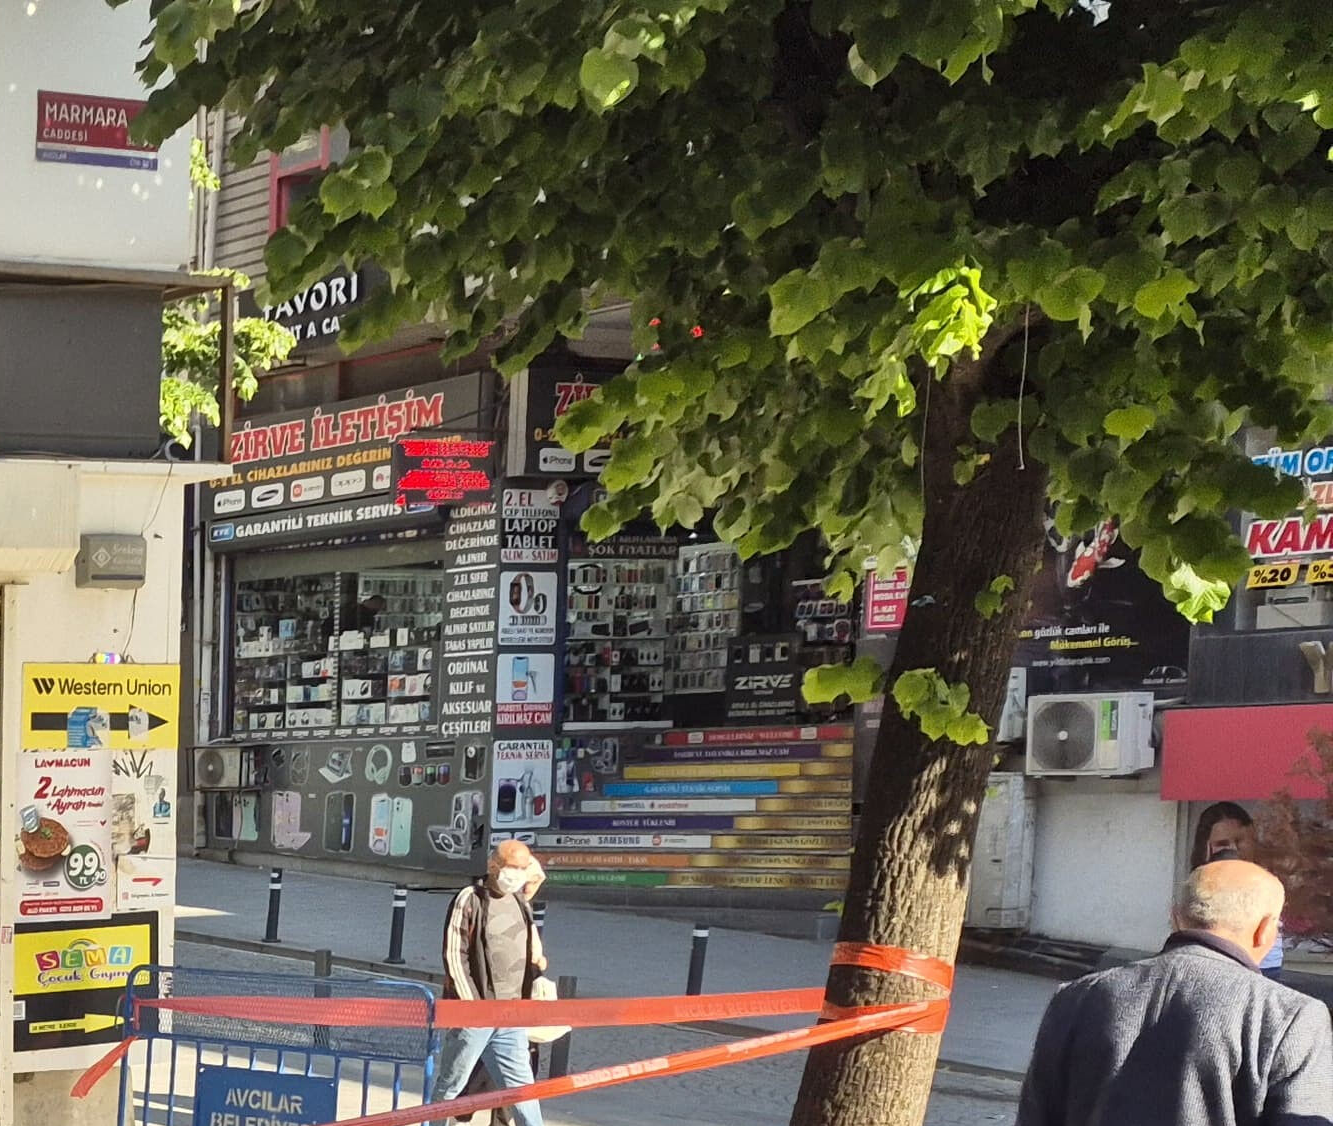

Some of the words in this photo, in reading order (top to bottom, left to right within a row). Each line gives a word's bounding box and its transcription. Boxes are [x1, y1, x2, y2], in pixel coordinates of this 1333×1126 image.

[45, 101, 128, 128] MARMARA
[321, 314, 346, 335] CA
[230, 420, 305, 465] ZİRVE
[311, 389, 444, 452] İLETİŞİM
[235, 512, 303, 538] GARANTİLİ
[306, 507, 353, 528] TEKNİK
[505, 519, 558, 533] LAPTOP
[505, 534, 555, 549] TABLET
[1253, 567, 1292, 584] %20
[1034, 625, 1062, 638] gözlük
[1098, 622, 1110, 633] ile
[58, 678, 123, 696] Western
[127, 679, 171, 696] Union
[441, 700, 492, 715] AKSESUAR
[441, 716, 492, 738] ÇEŞİTLERİ
[34, 776, 52, 799] 2
[51, 785, 105, 798] Lahmacun
[597, 836, 640, 844] SAMSUNG
[69, 852, 99, 877] 99
[79, 876, 89, 885] TL
[38, 947, 129, 970] SEMA
[37, 970, 82, 987] Çocuk
[225, 1088, 303, 1115] AVCILAR
